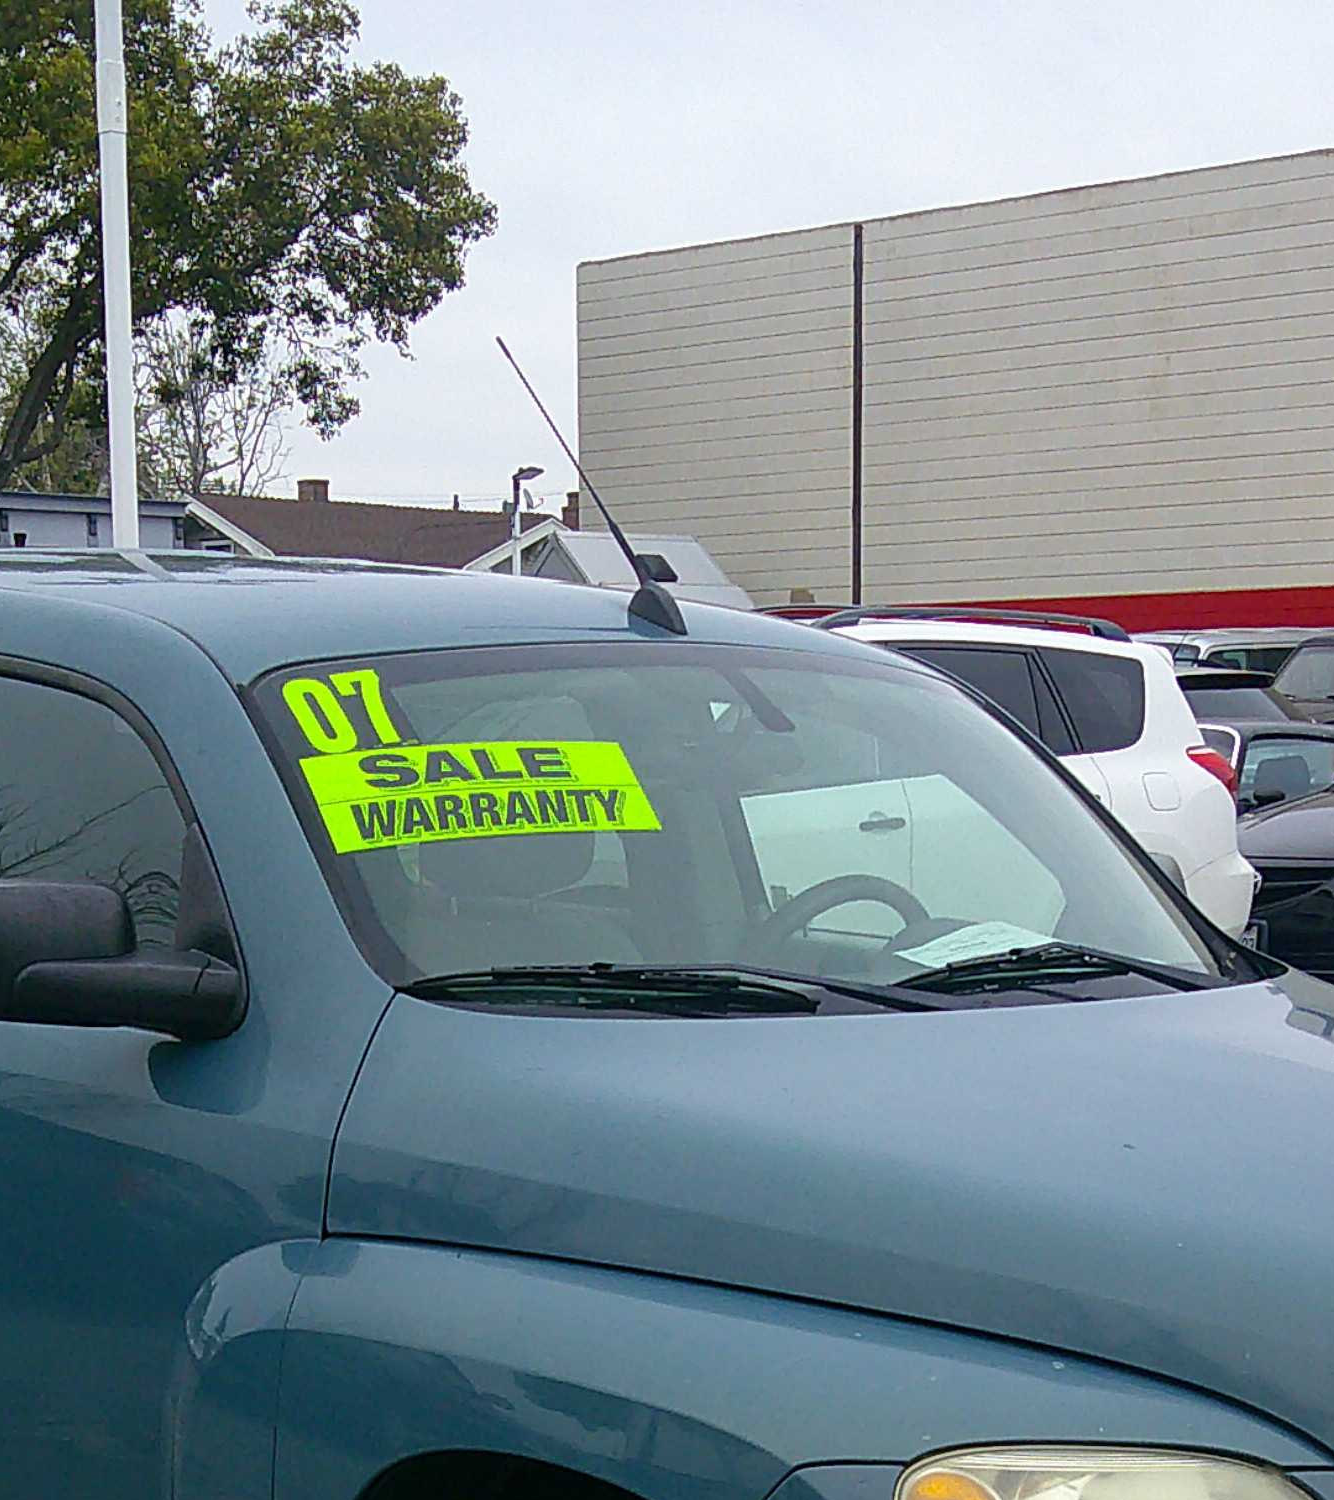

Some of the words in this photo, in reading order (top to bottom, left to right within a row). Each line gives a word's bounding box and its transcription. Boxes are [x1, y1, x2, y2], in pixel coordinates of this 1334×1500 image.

[282, 668, 403, 754] 07
[358, 746, 577, 790] SALE
[350, 789, 624, 844] WARRANTY
